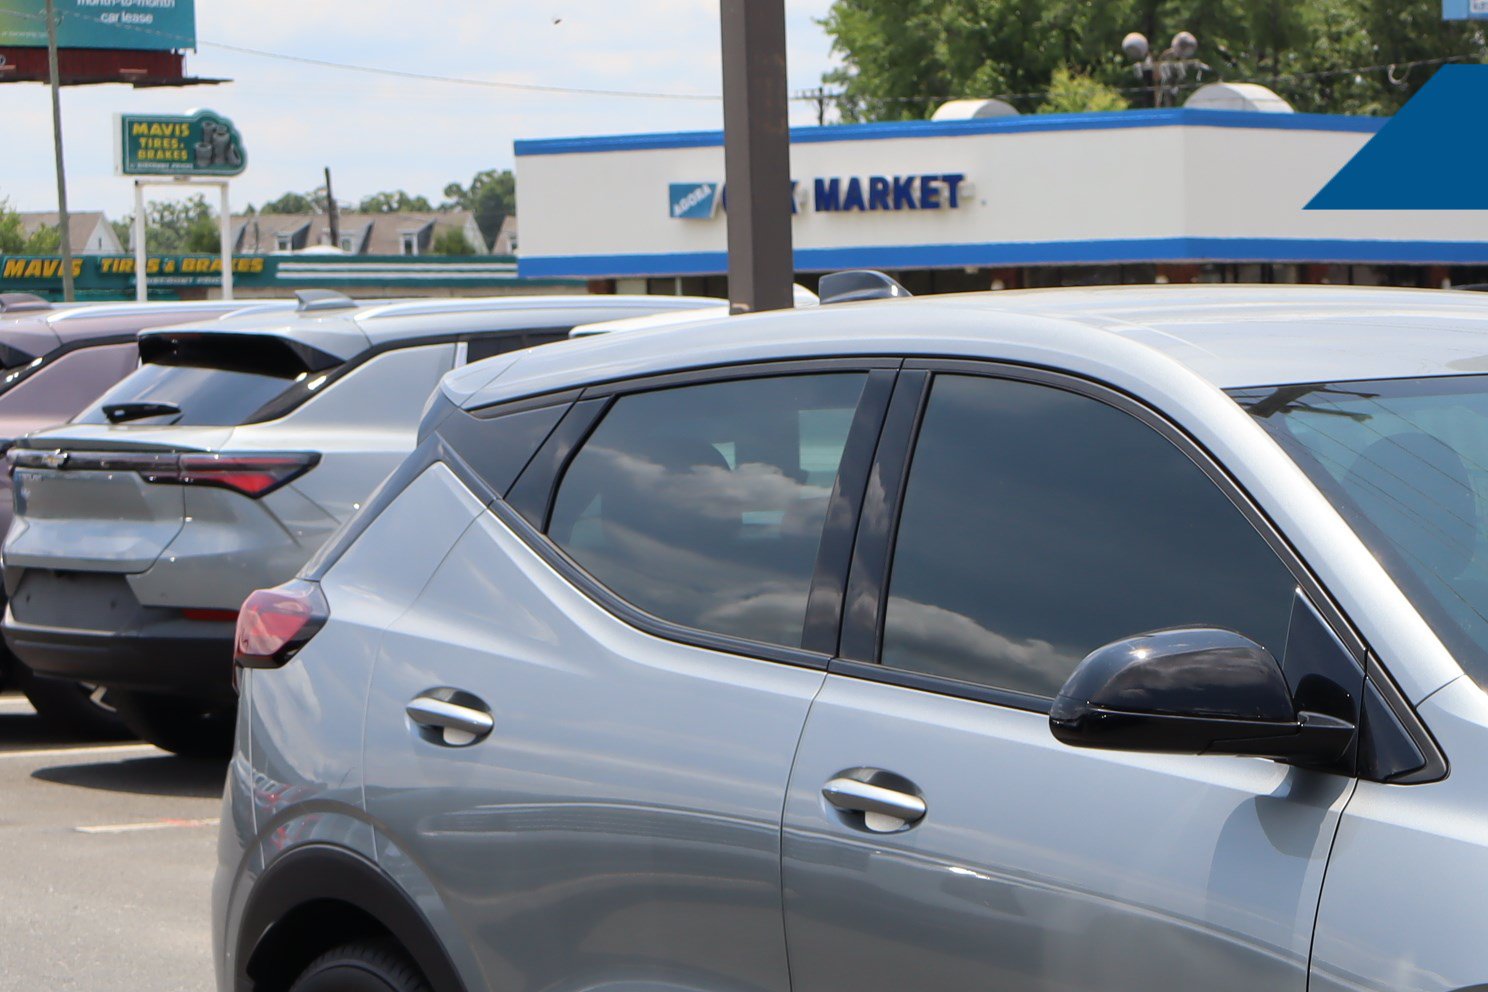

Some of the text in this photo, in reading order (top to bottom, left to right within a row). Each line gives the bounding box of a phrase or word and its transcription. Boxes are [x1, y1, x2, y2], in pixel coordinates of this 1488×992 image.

[100, 11, 154, 24] car lease
[132, 122, 190, 137] MAVIS
[139, 137, 179, 149] TIRES
[137, 149, 188, 161] BRAKES
[814, 174, 965, 212] MARKET
[101, 258, 160, 273] TIRS
[181, 258, 264, 273] BRAES
